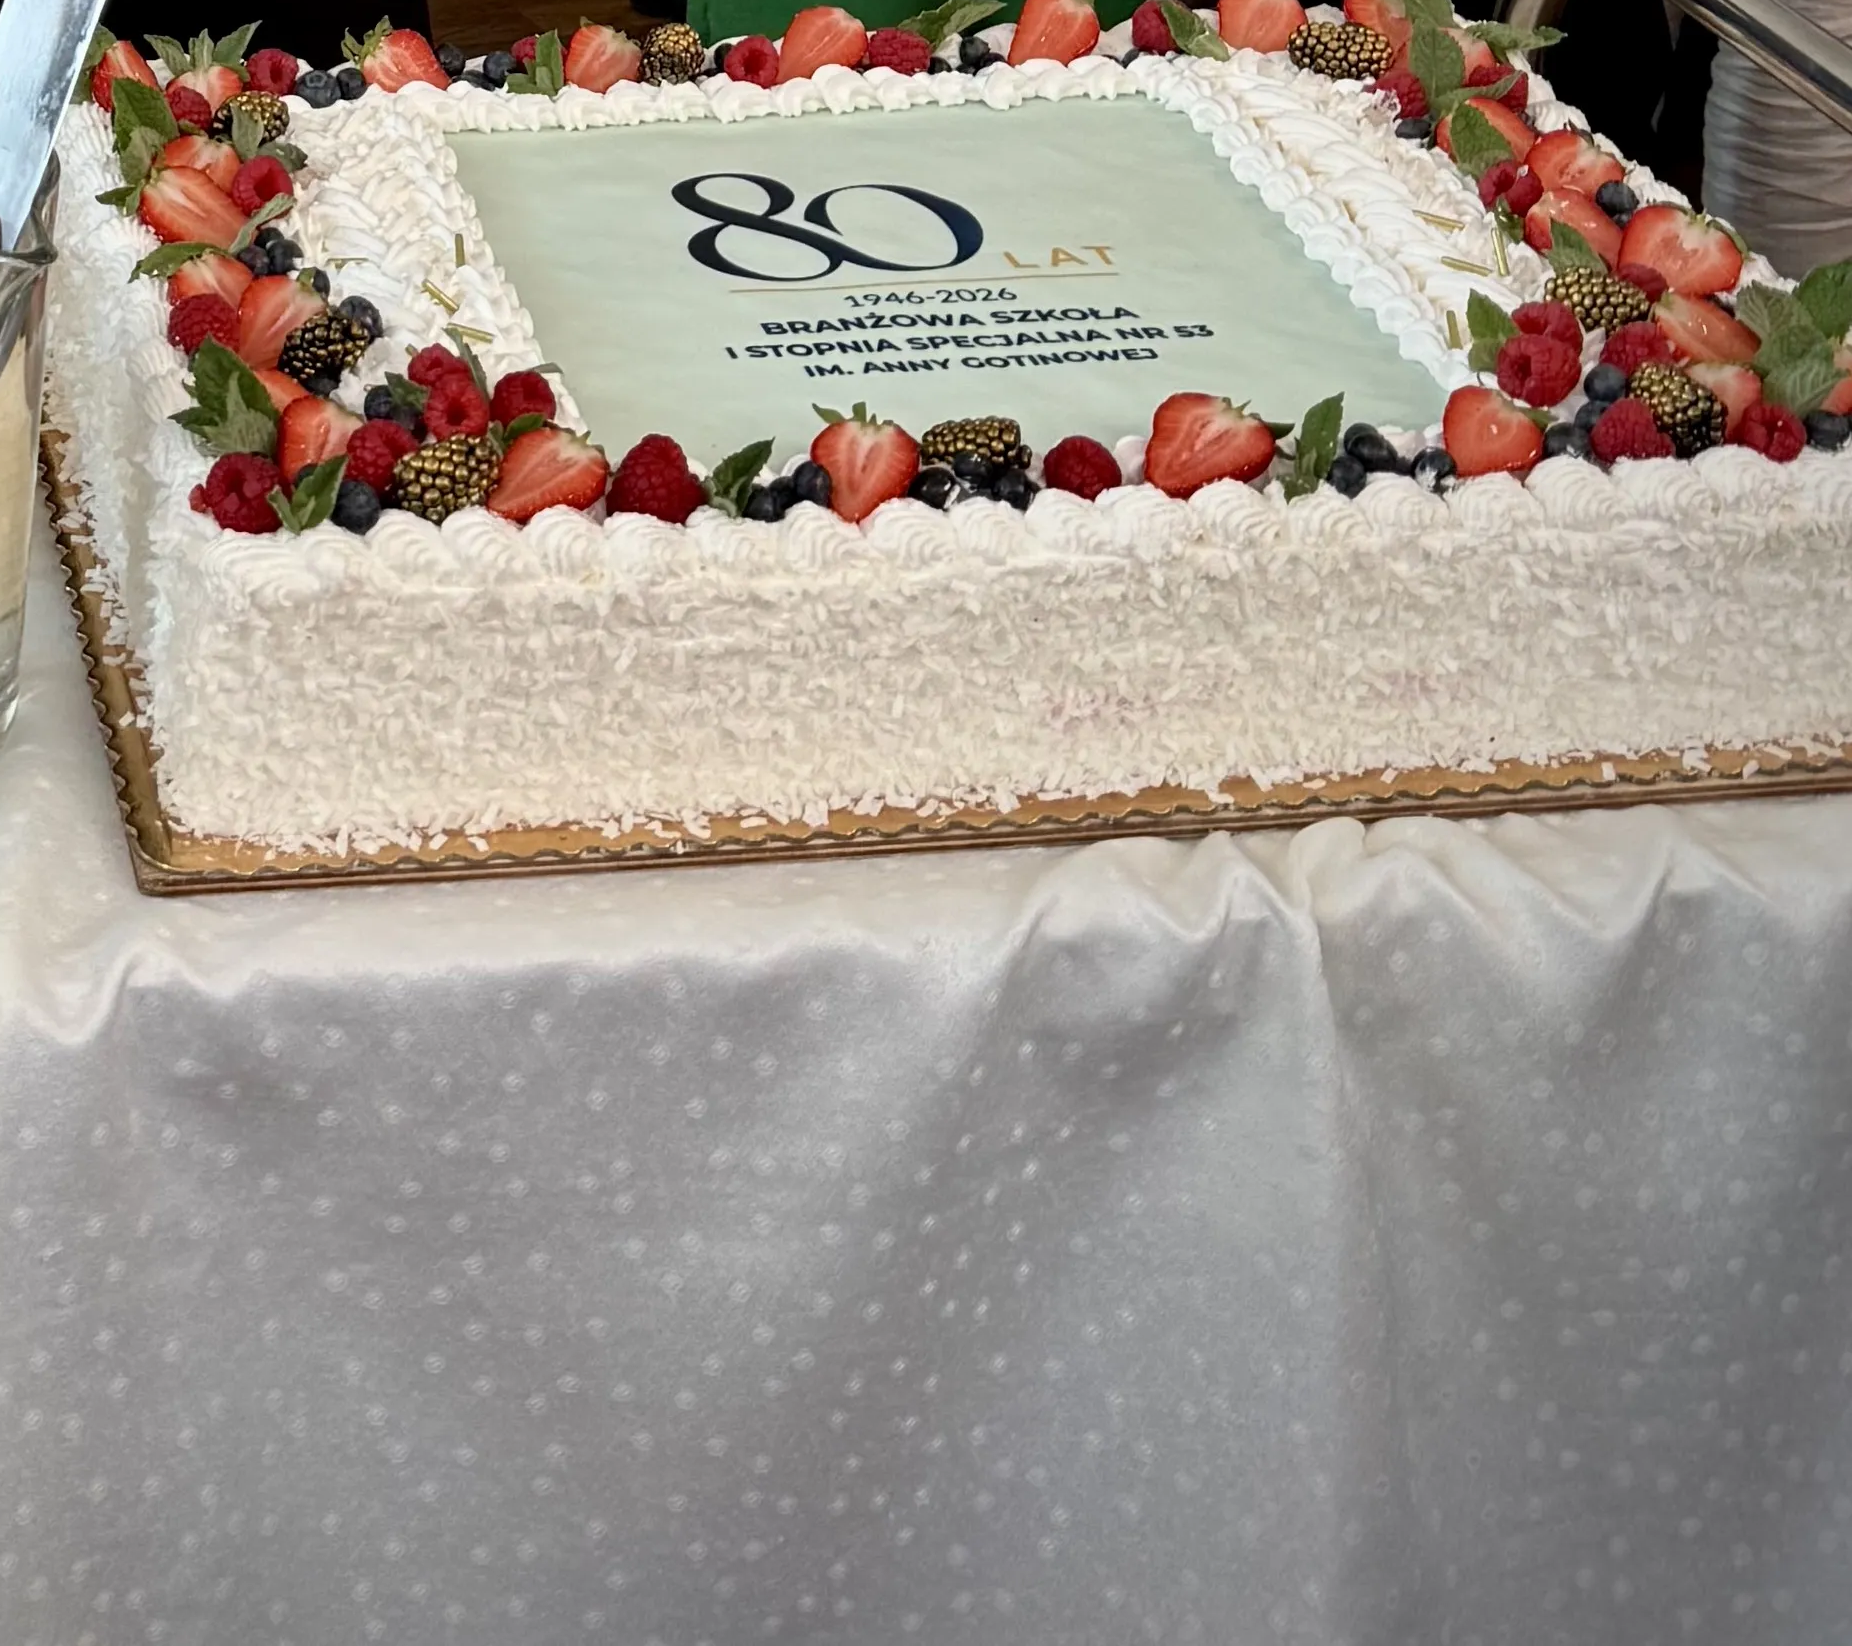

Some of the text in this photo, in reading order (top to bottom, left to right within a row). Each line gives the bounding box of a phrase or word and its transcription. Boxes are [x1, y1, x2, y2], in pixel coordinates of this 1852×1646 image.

[671, 173, 1115, 282] 80 LAT
[844, 287, 1018, 308] 1946-2026
[759, 306, 1141, 336] BRANŻOWA SZKOŁA
[724, 323, 1215, 360] I STOPNIA SPECJALNA NR 53
[803, 347, 1160, 378] IM. ANNY GOTINOWEJ
